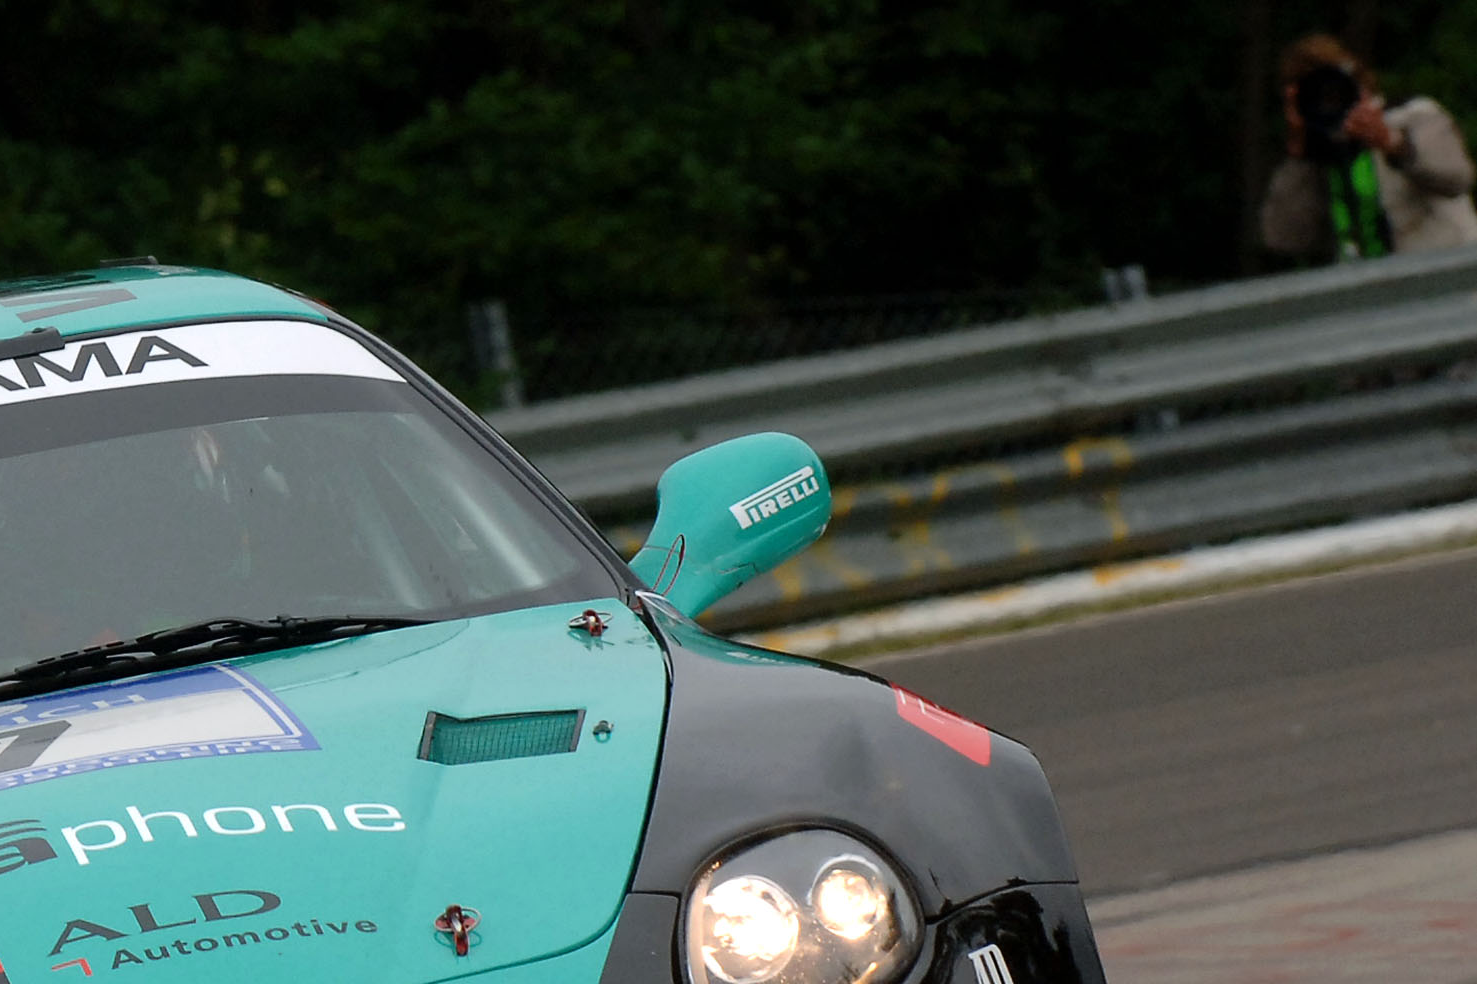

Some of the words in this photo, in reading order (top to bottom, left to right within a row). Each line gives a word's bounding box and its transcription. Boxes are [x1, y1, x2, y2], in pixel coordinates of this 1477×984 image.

[729, 466, 820, 530] PIRELLI
[47, 889, 282, 957] ALD
[111, 917, 379, 970] Automotive
